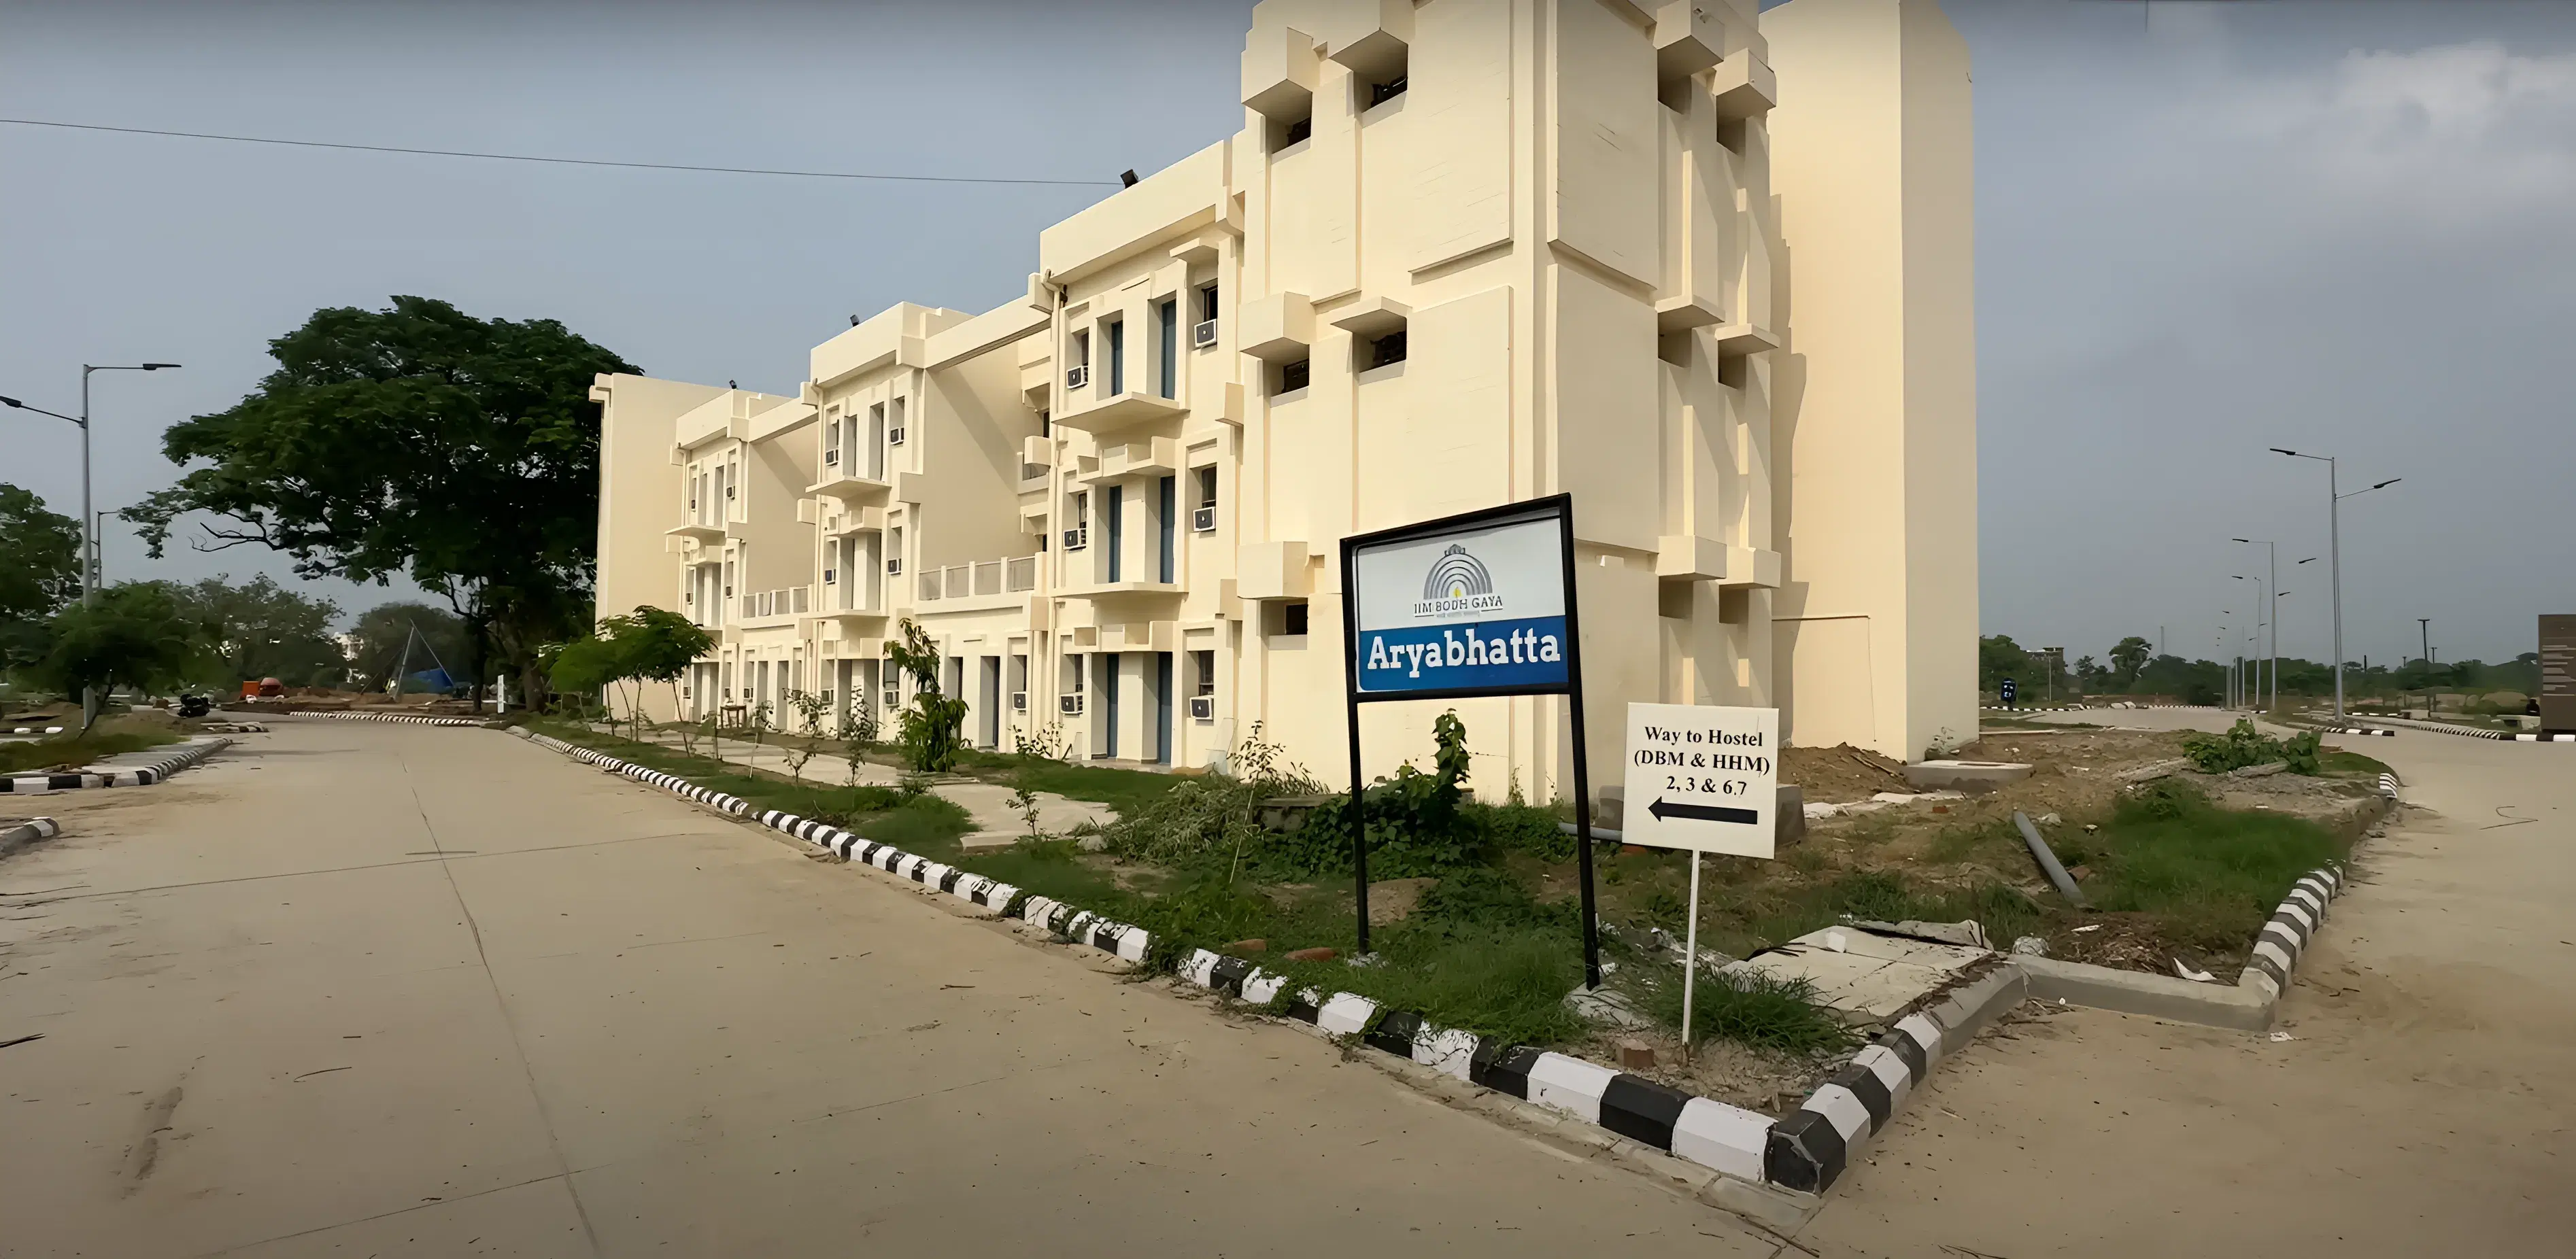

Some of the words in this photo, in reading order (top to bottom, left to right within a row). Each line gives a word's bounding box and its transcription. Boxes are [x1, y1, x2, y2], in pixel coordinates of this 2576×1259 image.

[1414, 602, 1431, 614] IIM
[1436, 598, 1468, 612] BODH
[1472, 596, 1503, 608] GAYA
[1368, 627, 1561, 678] Aryabhatta
[1644, 726, 1681, 746] Way
[1687, 729, 1702, 743] to
[1708, 729, 1763, 747] Hostel
[1634, 749, 1684, 767] (DBM
[1690, 753, 1706, 768] &
[1712, 754, 1770, 776] HHM)
[1666, 776, 1680, 793] 2,
[1685, 776, 1695, 792] 3
[1701, 778, 1716, 793] &
